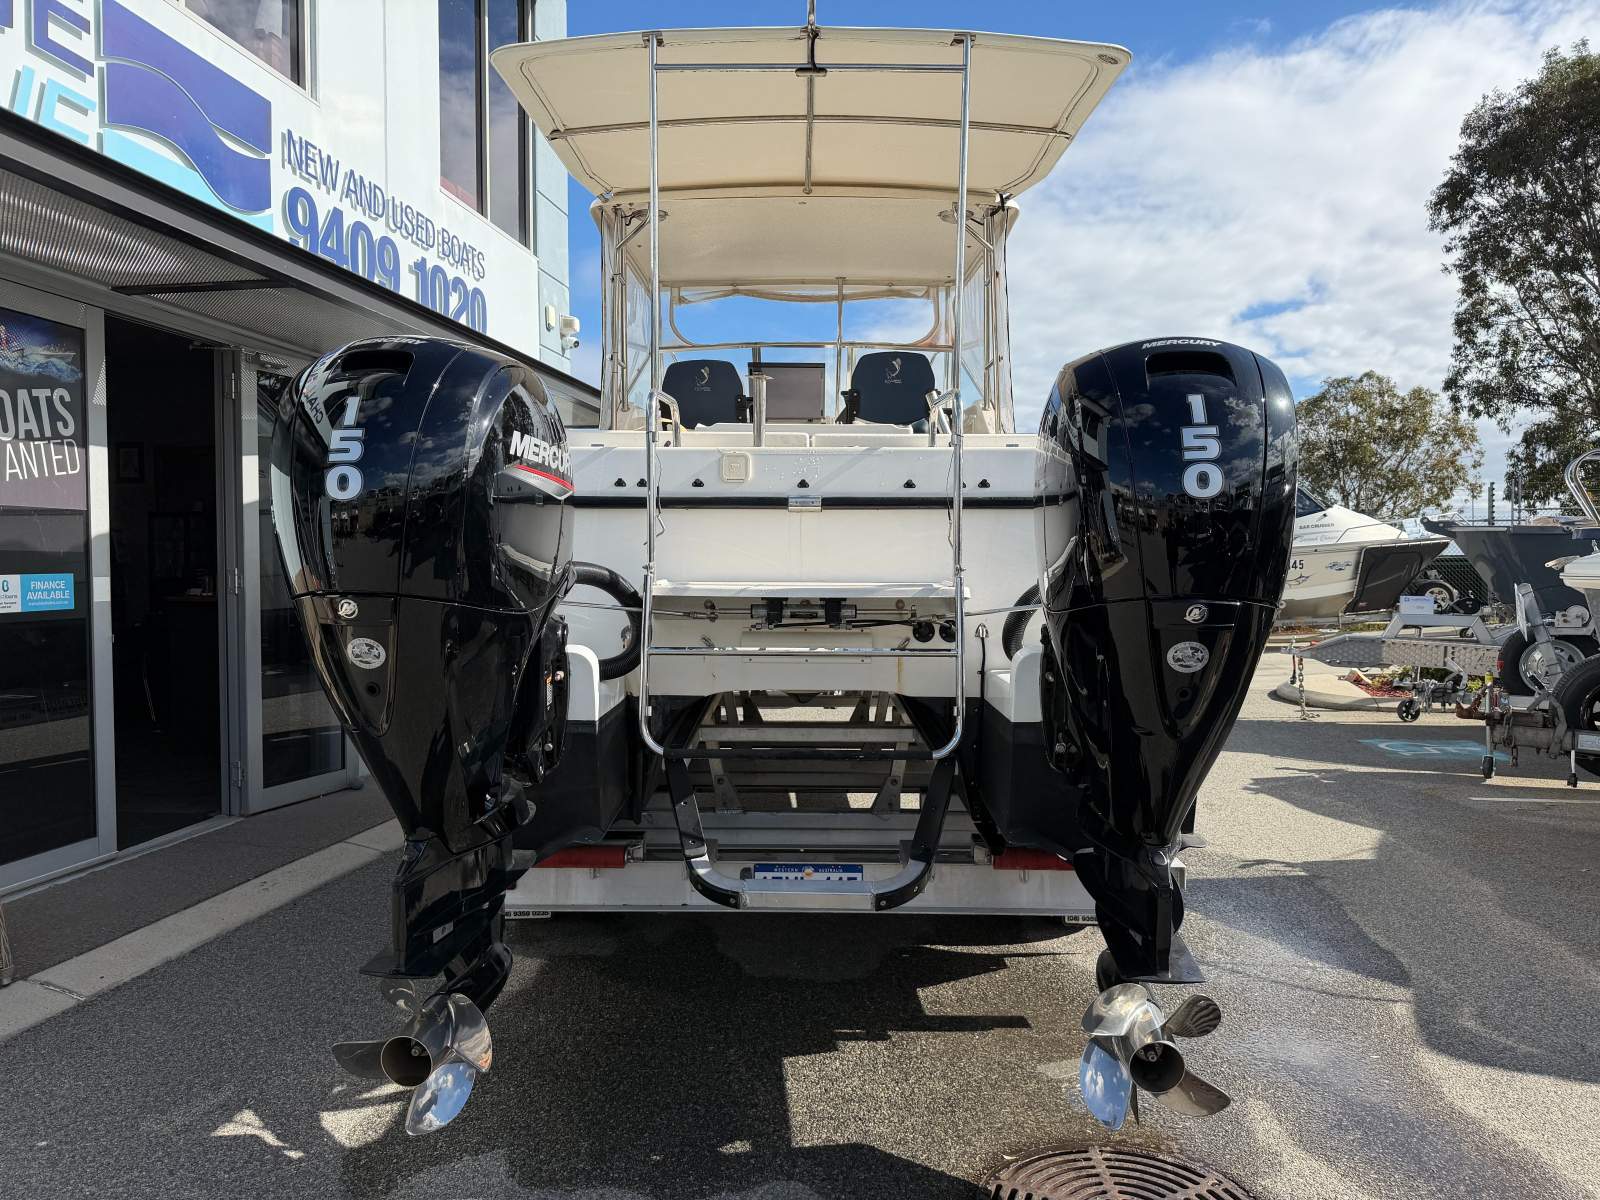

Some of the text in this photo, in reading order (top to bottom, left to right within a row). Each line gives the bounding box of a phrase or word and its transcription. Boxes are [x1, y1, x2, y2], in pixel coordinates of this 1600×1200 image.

[286, 128, 486, 280] NEW AND USED BOATS
[286, 185, 488, 335] 9409 1020
[1141, 338, 1223, 350] MERCURY
[5, 438, 81, 483] ANTED
[27, 590, 71, 600] AVAILABLE
[31, 580, 66, 590] FINANCE
